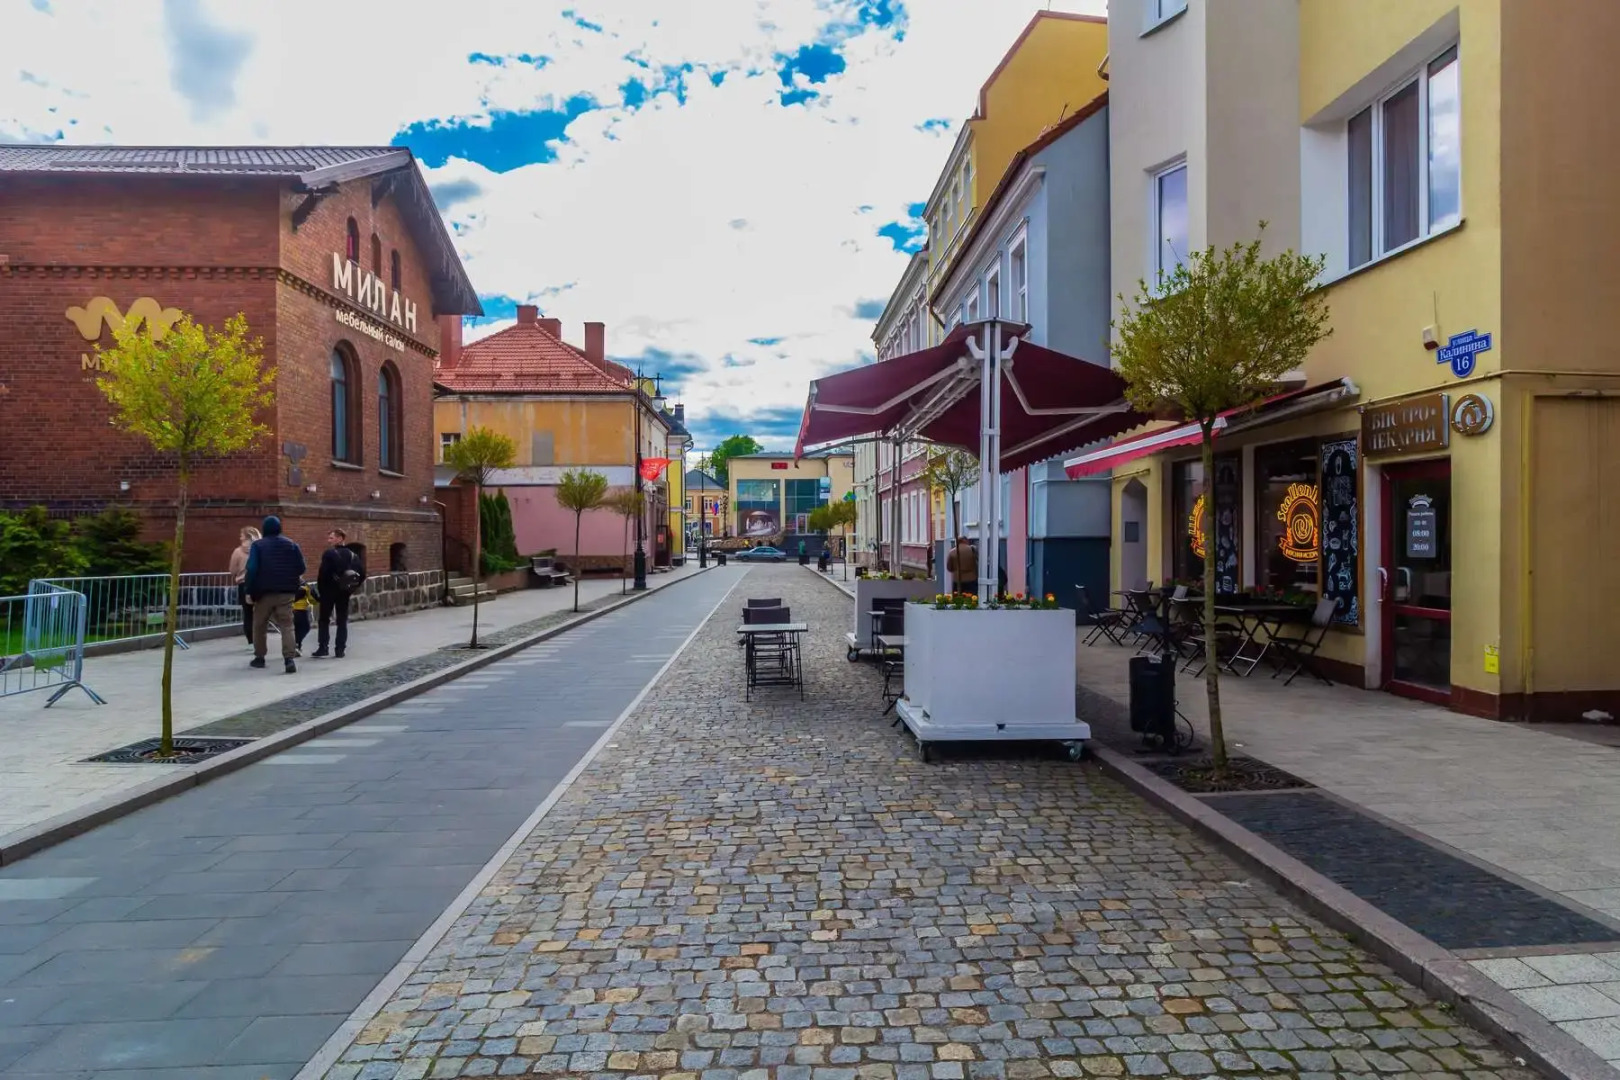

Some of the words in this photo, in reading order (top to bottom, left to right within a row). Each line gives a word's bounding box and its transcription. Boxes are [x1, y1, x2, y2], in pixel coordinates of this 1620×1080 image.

[333, 251, 417, 334] МИЛАН
[335, 309, 384, 342] мебельный
[385, 333, 405, 353] салон
[1439, 339, 1487, 361] Калинина
[1456, 355, 1470, 371] 16
